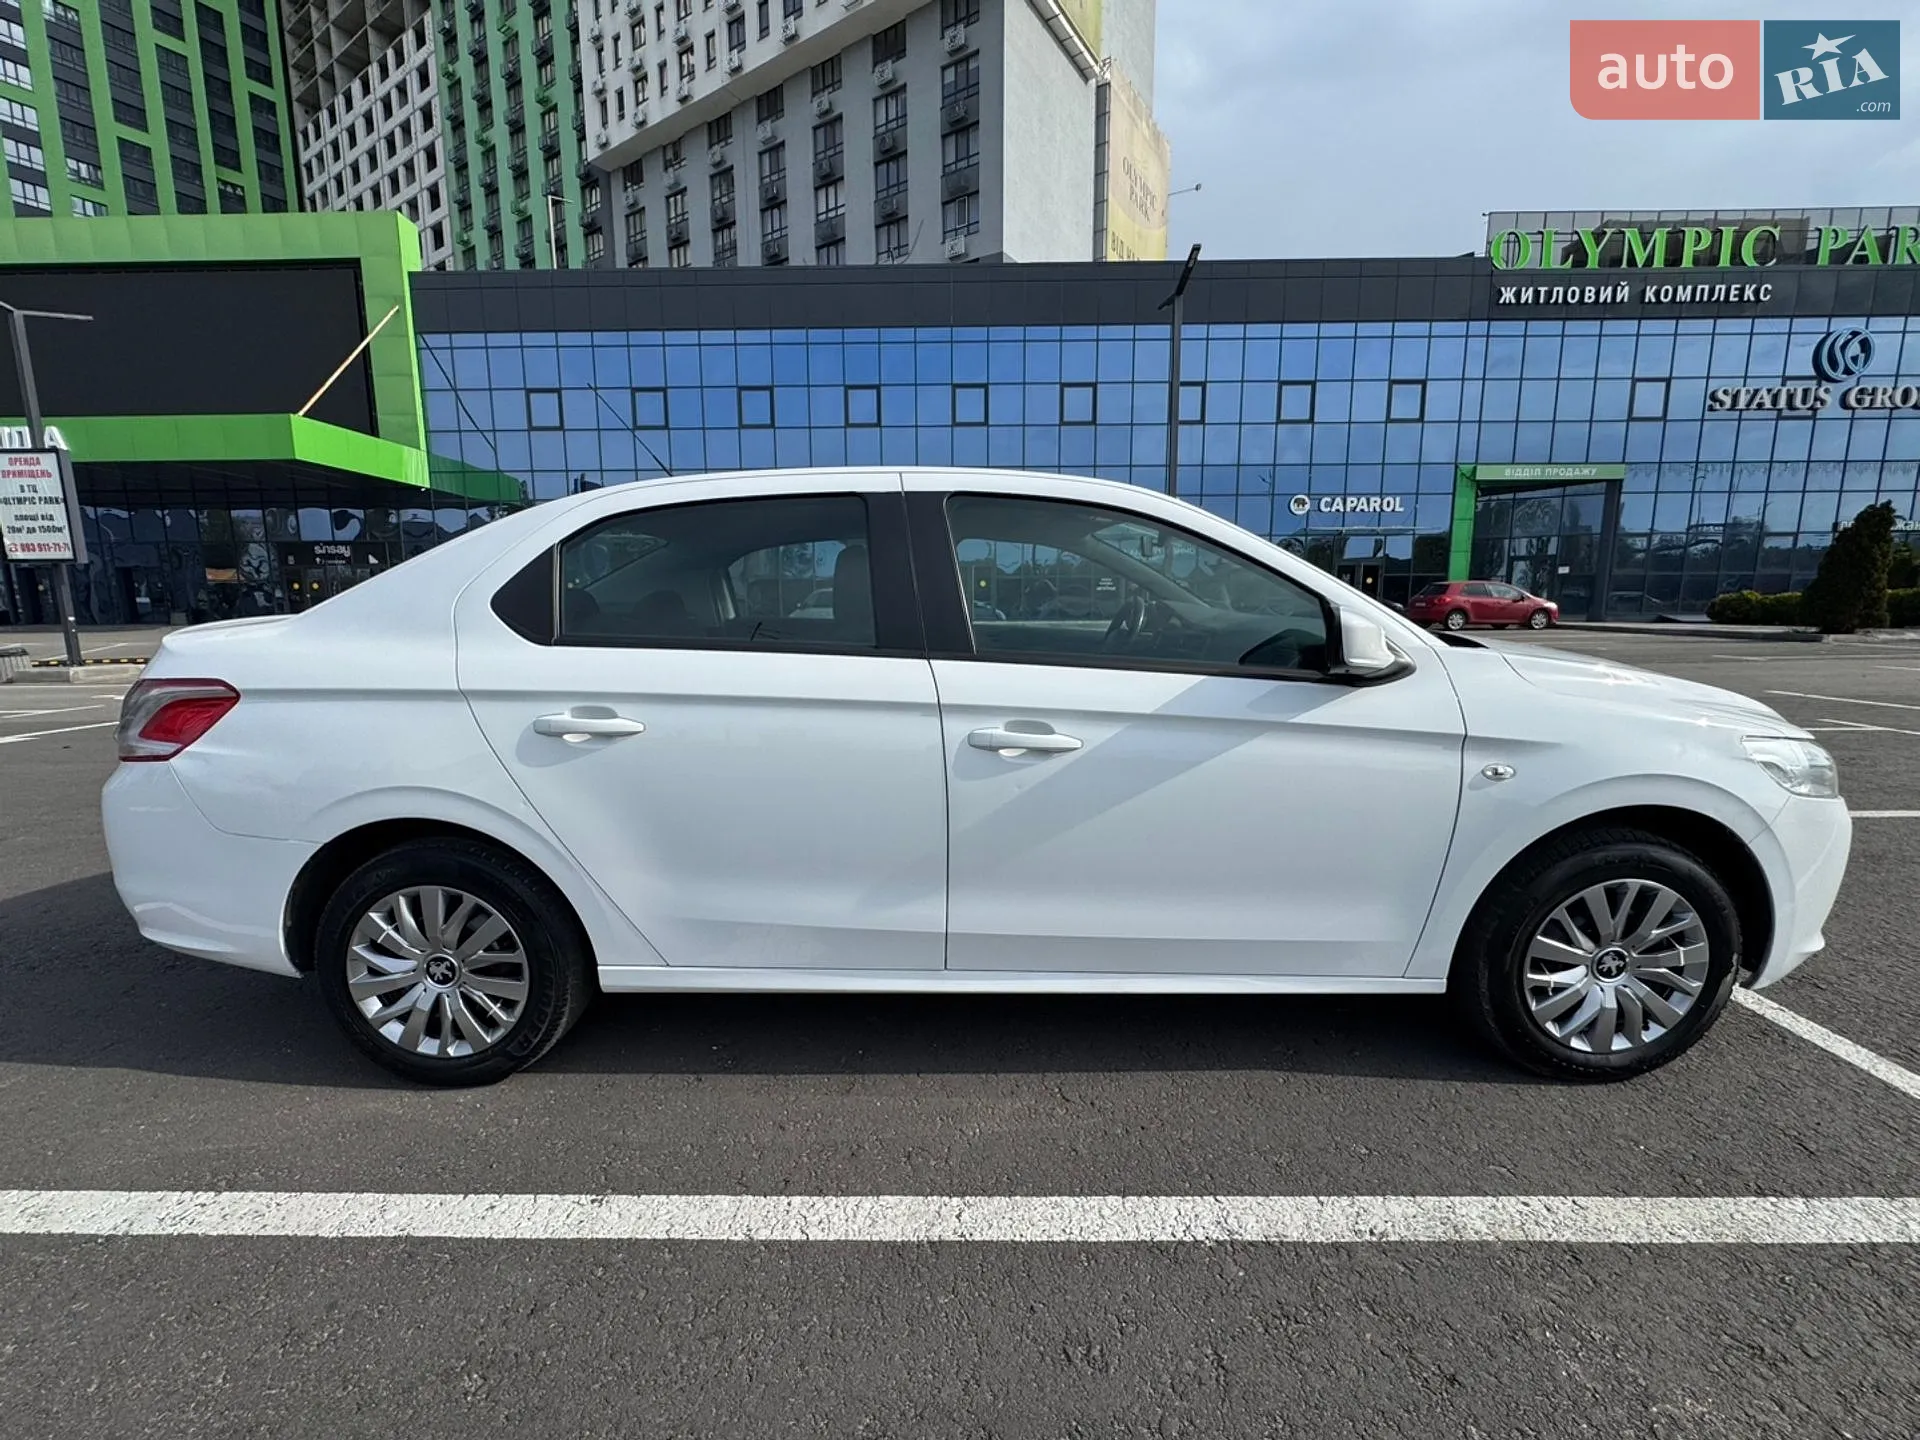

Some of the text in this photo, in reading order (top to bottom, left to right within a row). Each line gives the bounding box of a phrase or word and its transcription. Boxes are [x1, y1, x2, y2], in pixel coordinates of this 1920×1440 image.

[1122, 156, 1157, 211] OLYMPIC
[1129, 183, 1151, 223] PARK
[1489, 226, 1781, 270] OLYMPIC
[1499, 281, 1773, 304] ЖИТЛОВИЙ КОМПЛЕКС
[1708, 385, 1833, 411] STATUS
[8, 456, 41, 467] ОРЕНДА
[1, 469, 52, 479] ПРИМІЩЕНЬ
[1545, 467, 1597, 477] ПРОДАЖУ
[1319, 497, 1404, 512] CAPAROL
[314, 543, 351, 557] sinsay
